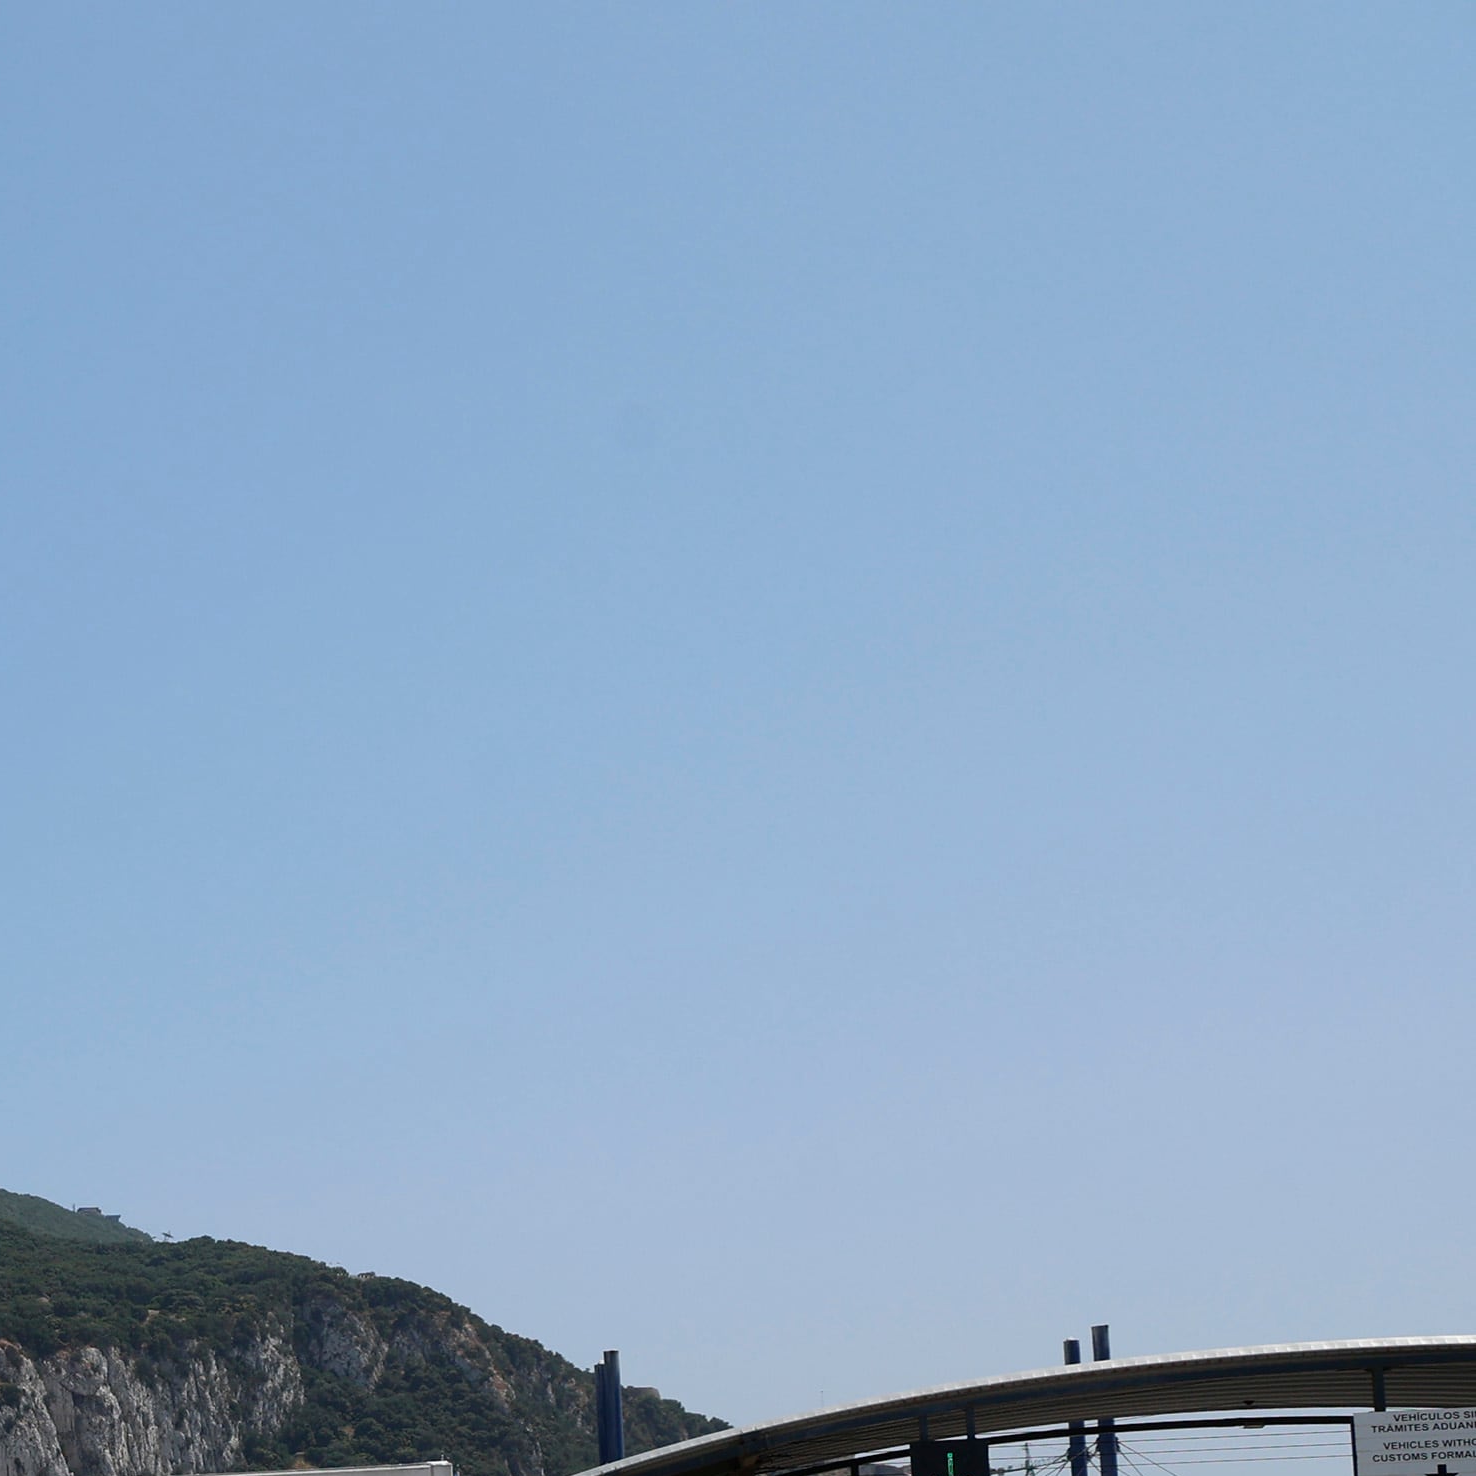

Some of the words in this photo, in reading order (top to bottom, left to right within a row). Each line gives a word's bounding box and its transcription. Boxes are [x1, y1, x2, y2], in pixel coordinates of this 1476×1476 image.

[1393, 1411, 1460, 1422] VEHÍCULOS
[1383, 1440, 1439, 1450] VEHICLES
[1372, 1452, 1428, 1462] CUSTOMS
